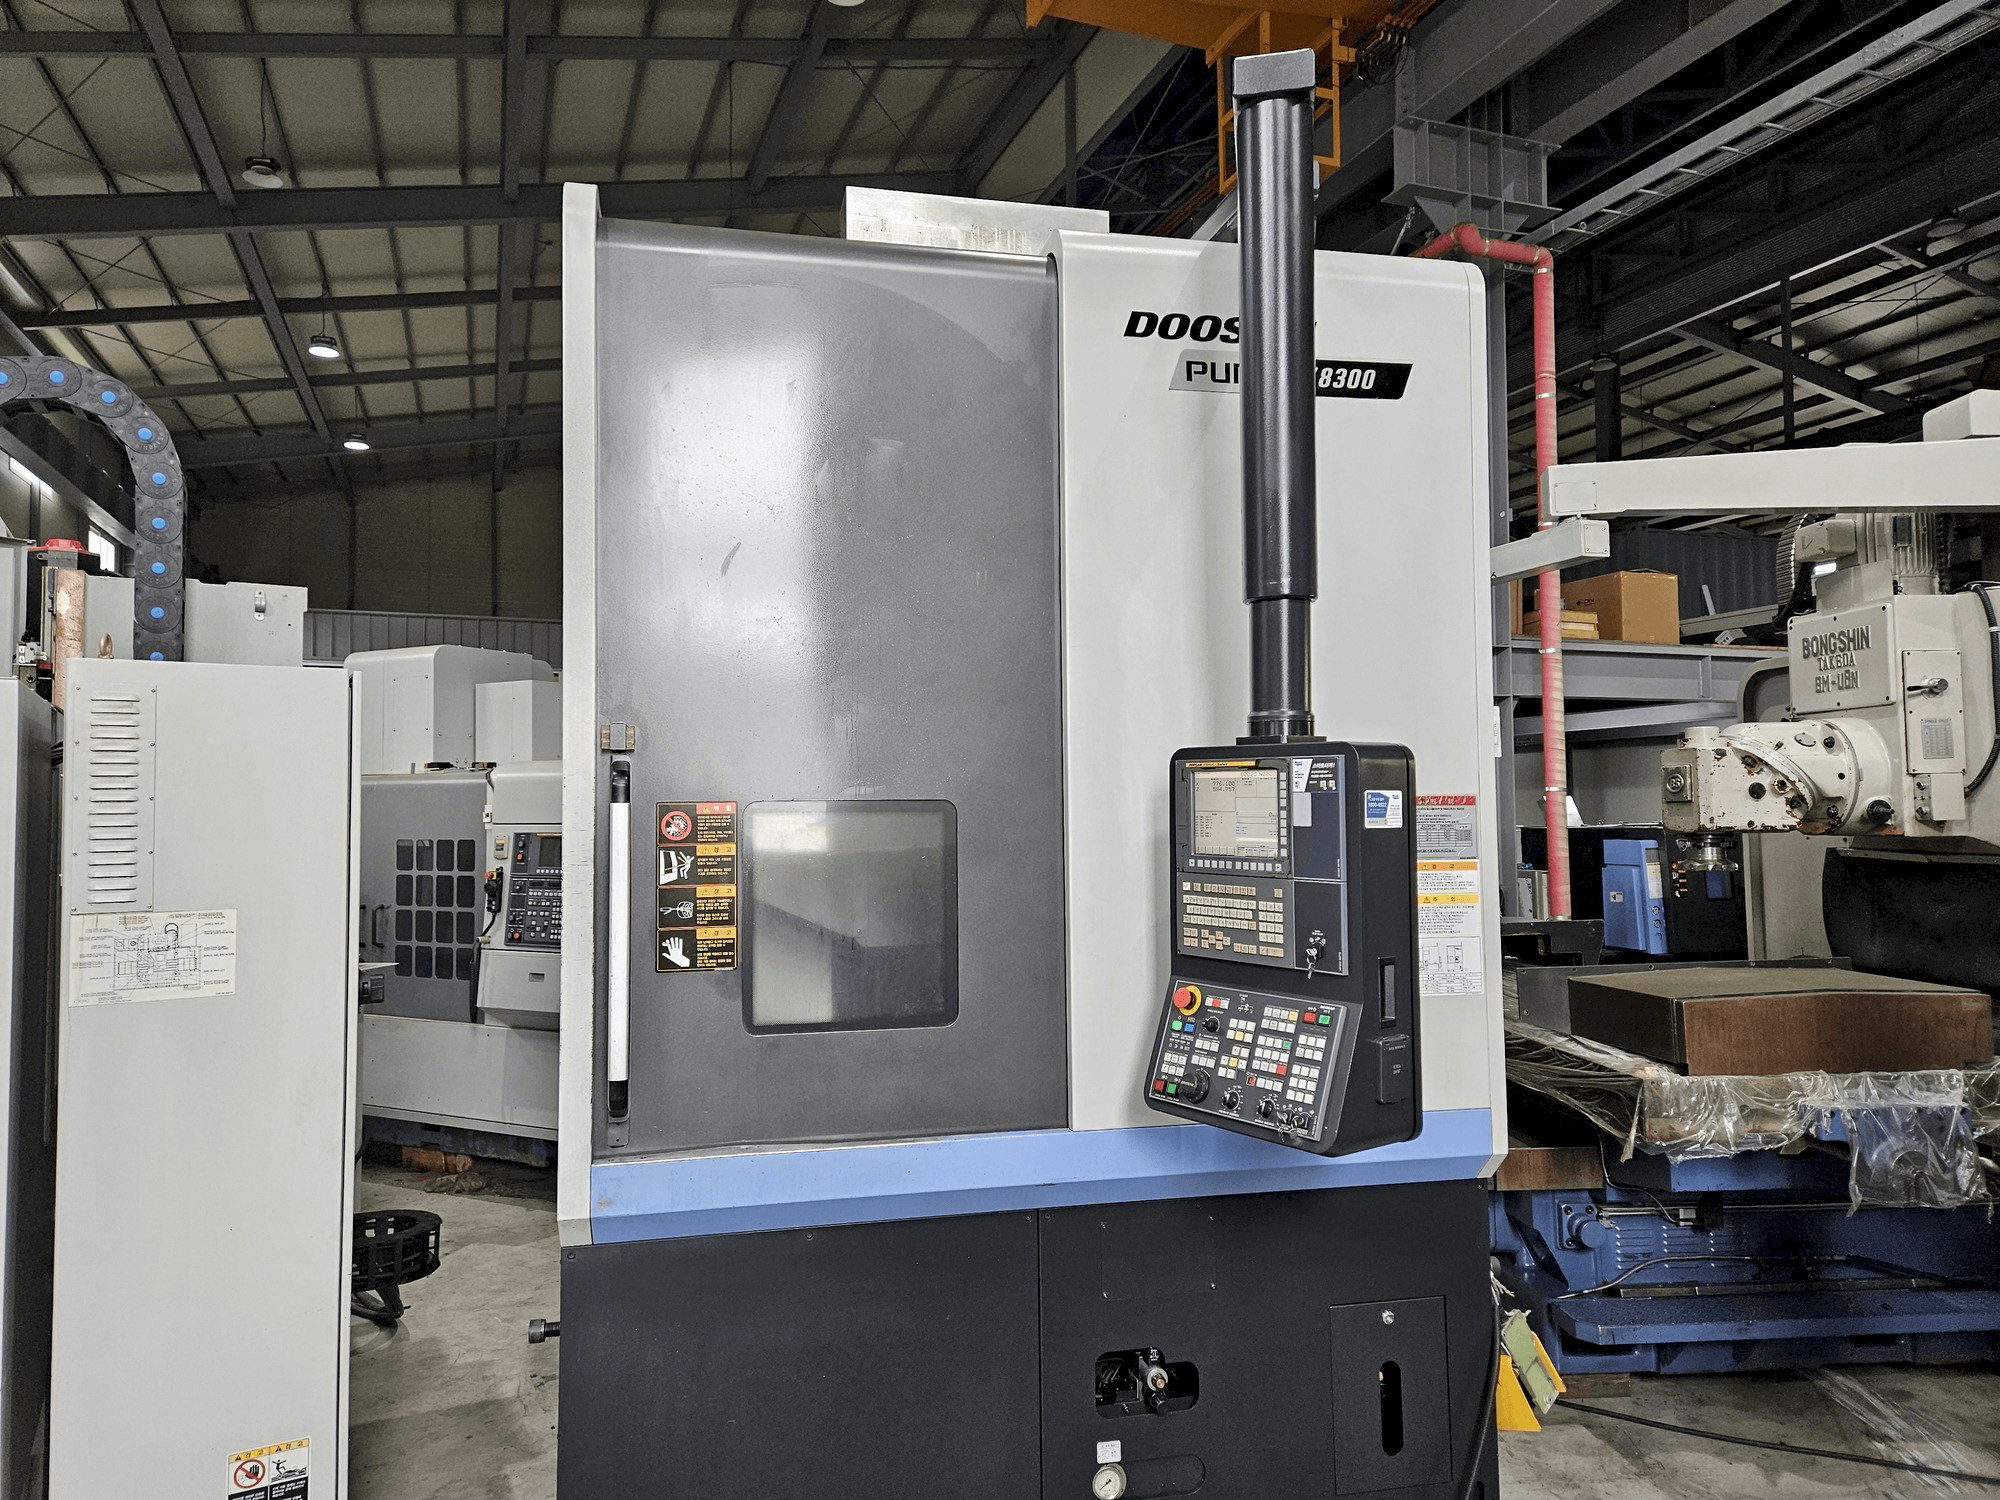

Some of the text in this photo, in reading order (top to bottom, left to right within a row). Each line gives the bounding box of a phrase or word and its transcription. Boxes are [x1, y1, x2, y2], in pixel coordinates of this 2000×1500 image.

[1186, 361, 1377, 390] PU 8300
[1802, 625, 1872, 659] BONGSHIN
[1817, 652, 1857, 671] TAKEDA
